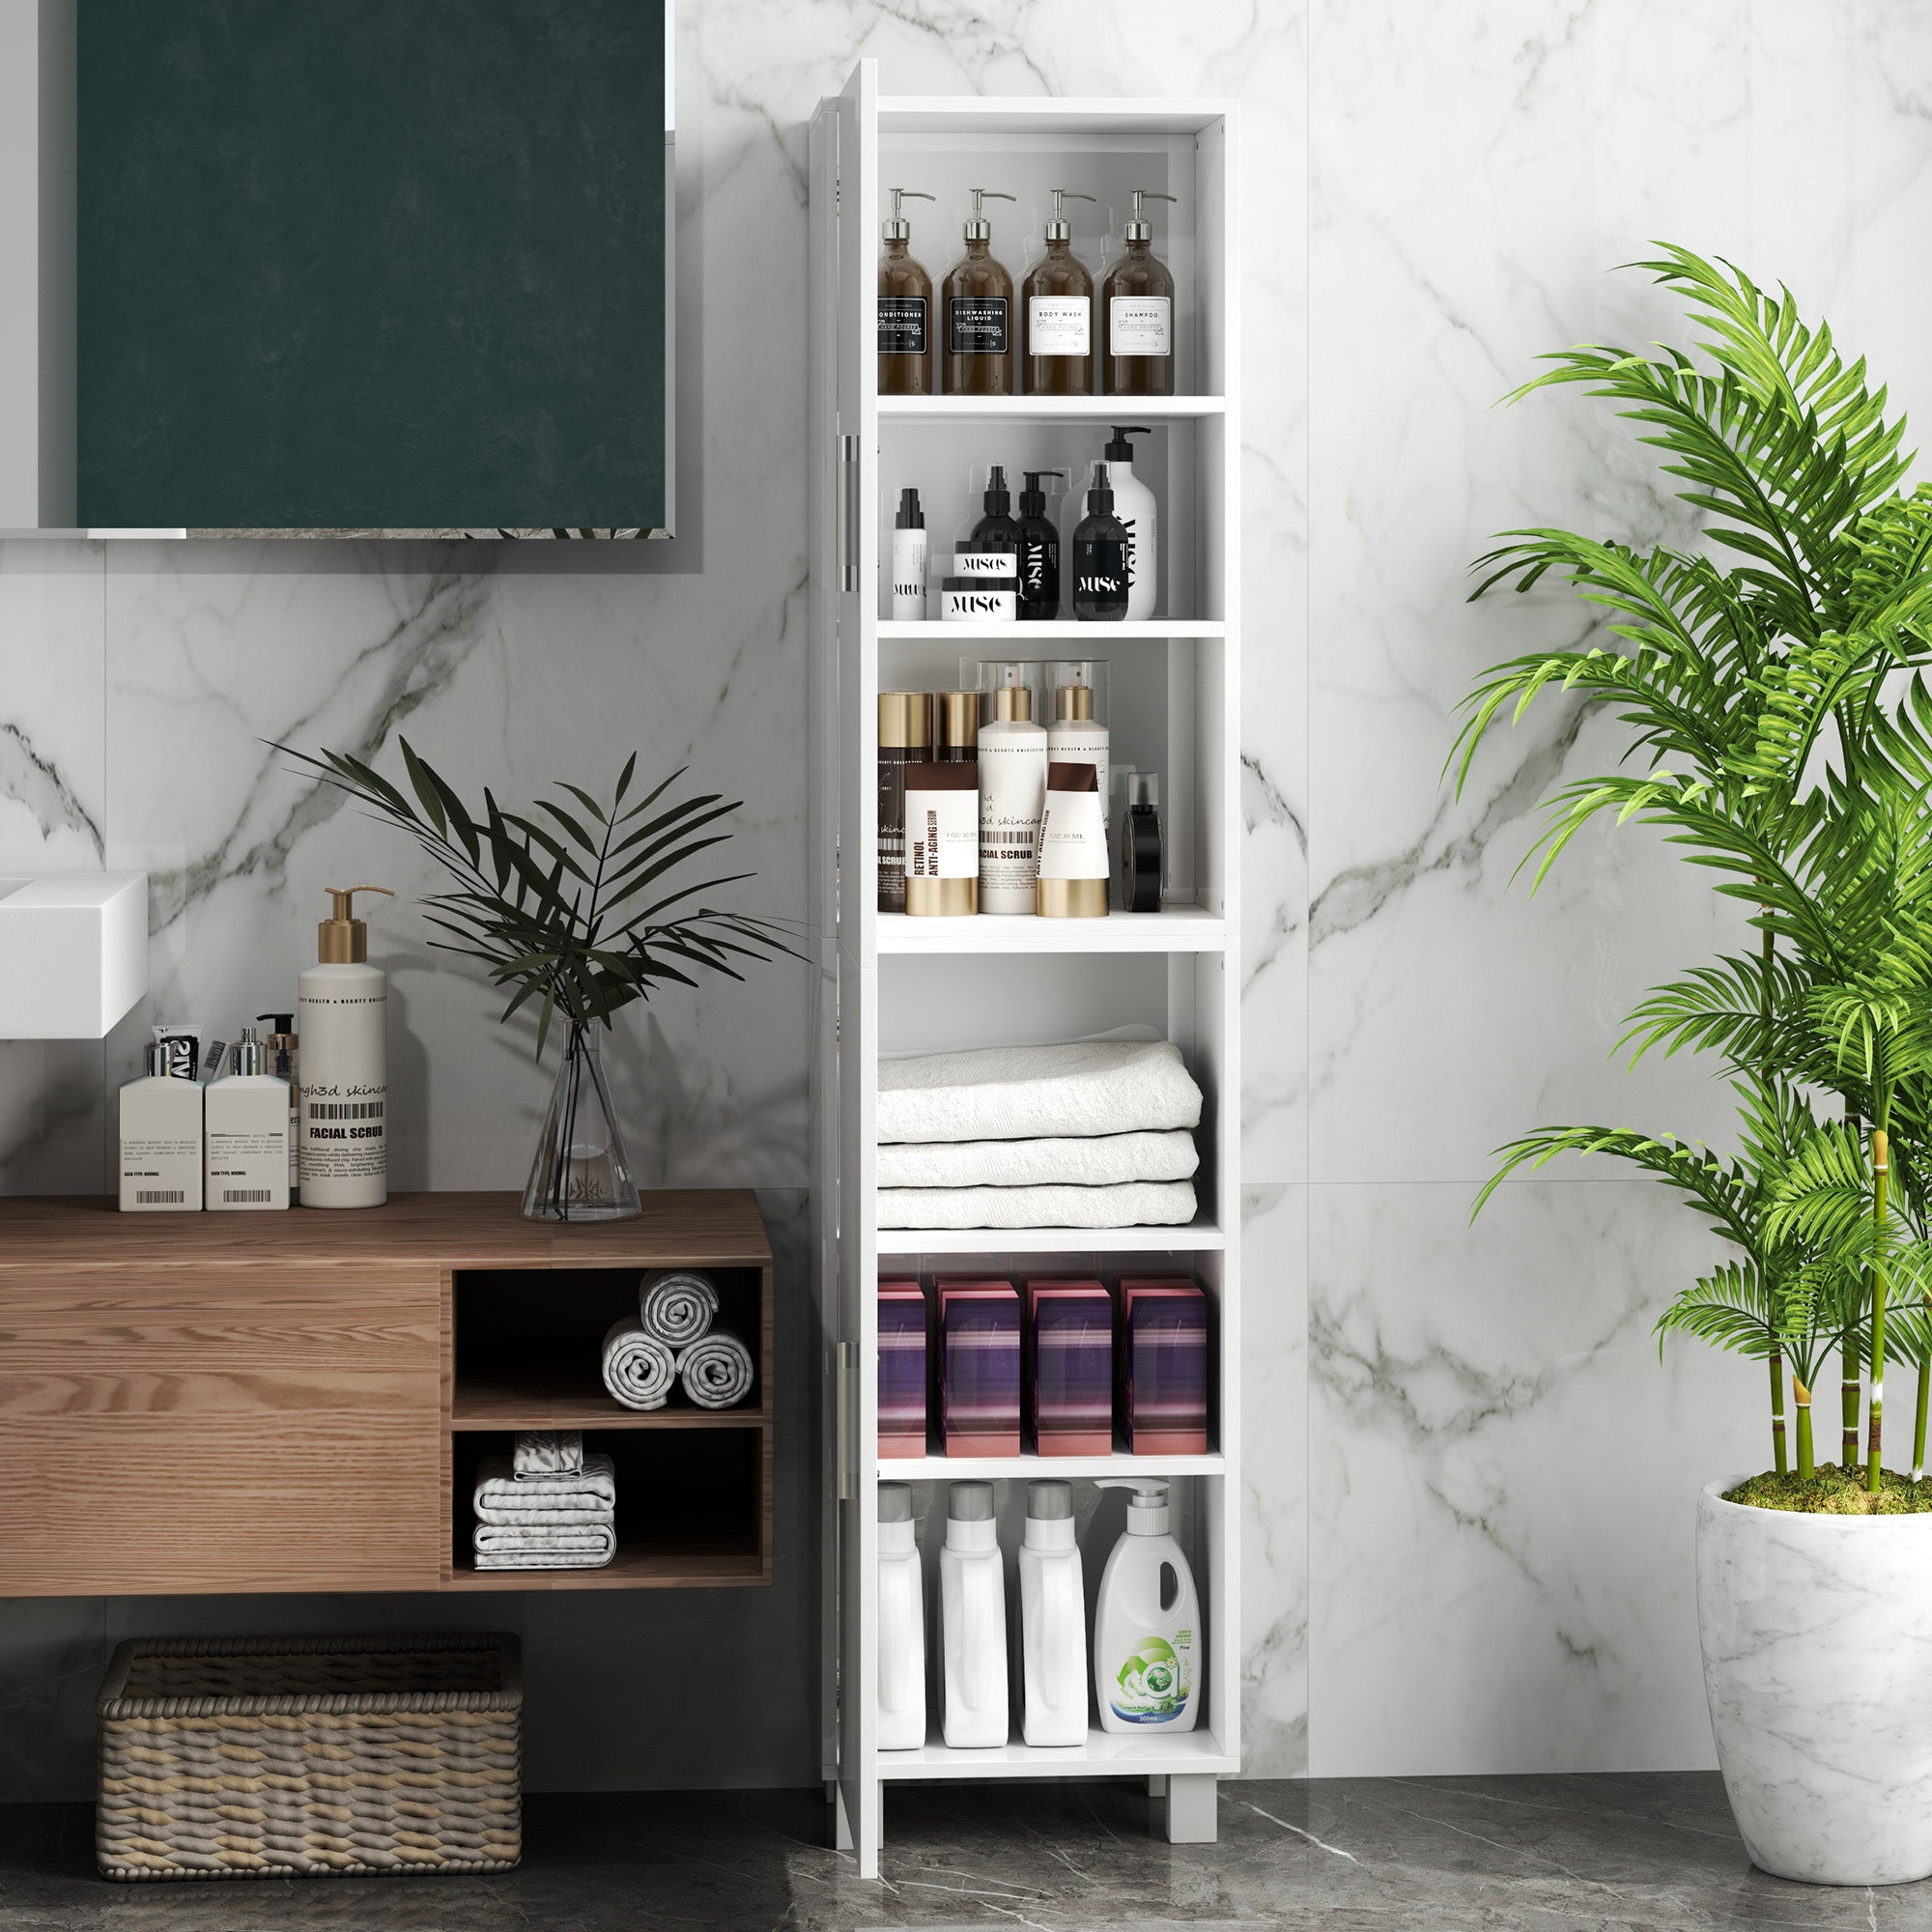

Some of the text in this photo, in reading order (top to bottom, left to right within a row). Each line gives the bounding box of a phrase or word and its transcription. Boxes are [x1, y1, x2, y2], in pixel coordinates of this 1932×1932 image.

[914, 841, 924, 875] RETINOL
[928, 827, 939, 876] ANTI-AGING
[1000, 850, 1033, 860] SCRUB
[310, 1125, 384, 1139] FACIAL SCRUB
